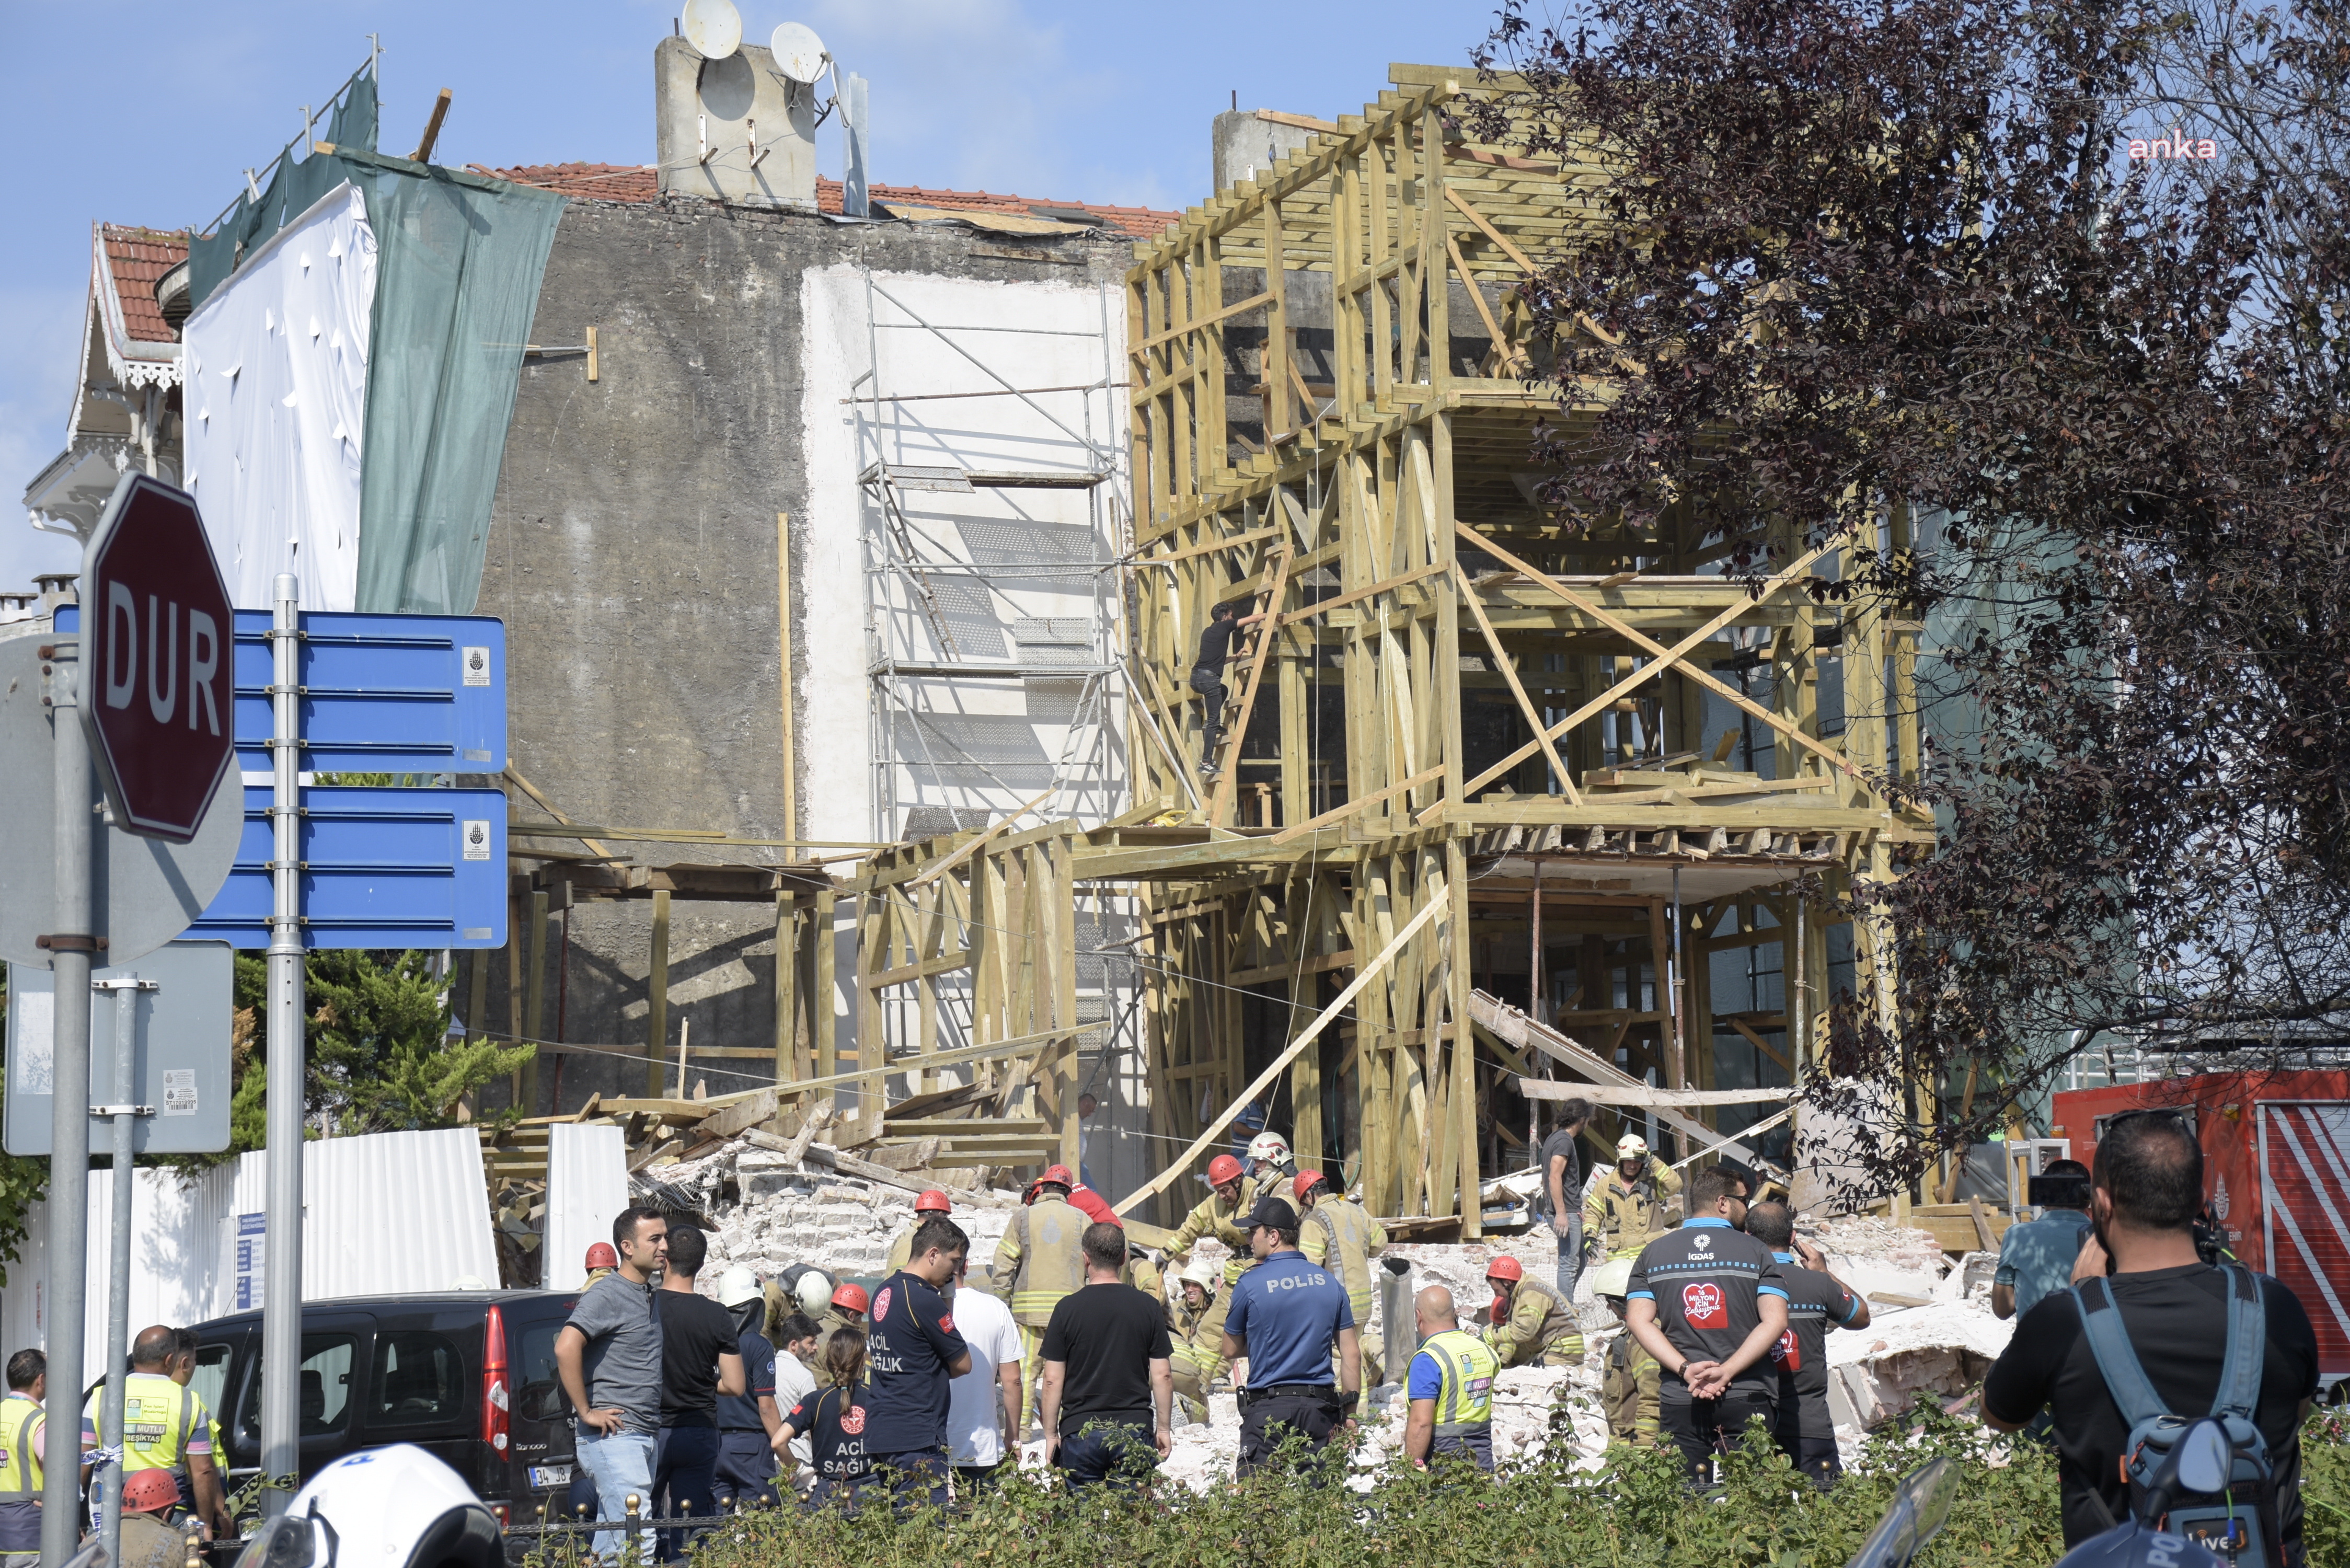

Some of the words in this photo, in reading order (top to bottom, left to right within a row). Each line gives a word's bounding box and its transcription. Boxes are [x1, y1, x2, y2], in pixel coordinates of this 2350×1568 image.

[106, 580, 221, 736] DUR
[1688, 1252, 1714, 1261] İGDAŞ
[870, 1332, 890, 1351] ACİL
[871, 1352, 903, 1372] AĞLIK
[1473, 1379, 1491, 1389] MUTLU
[1468, 1389, 1489, 1399] BEŞİKTAŞ
[137, 1425, 165, 1434] MUTLU
[125, 1434, 160, 1443] BEŞİKTAŞ
[835, 1438, 868, 1456] ACİ
[823, 1458, 874, 1474] SAĞLI
[536, 1469, 549, 1484] 34
[556, 1467, 567, 1482] JB
